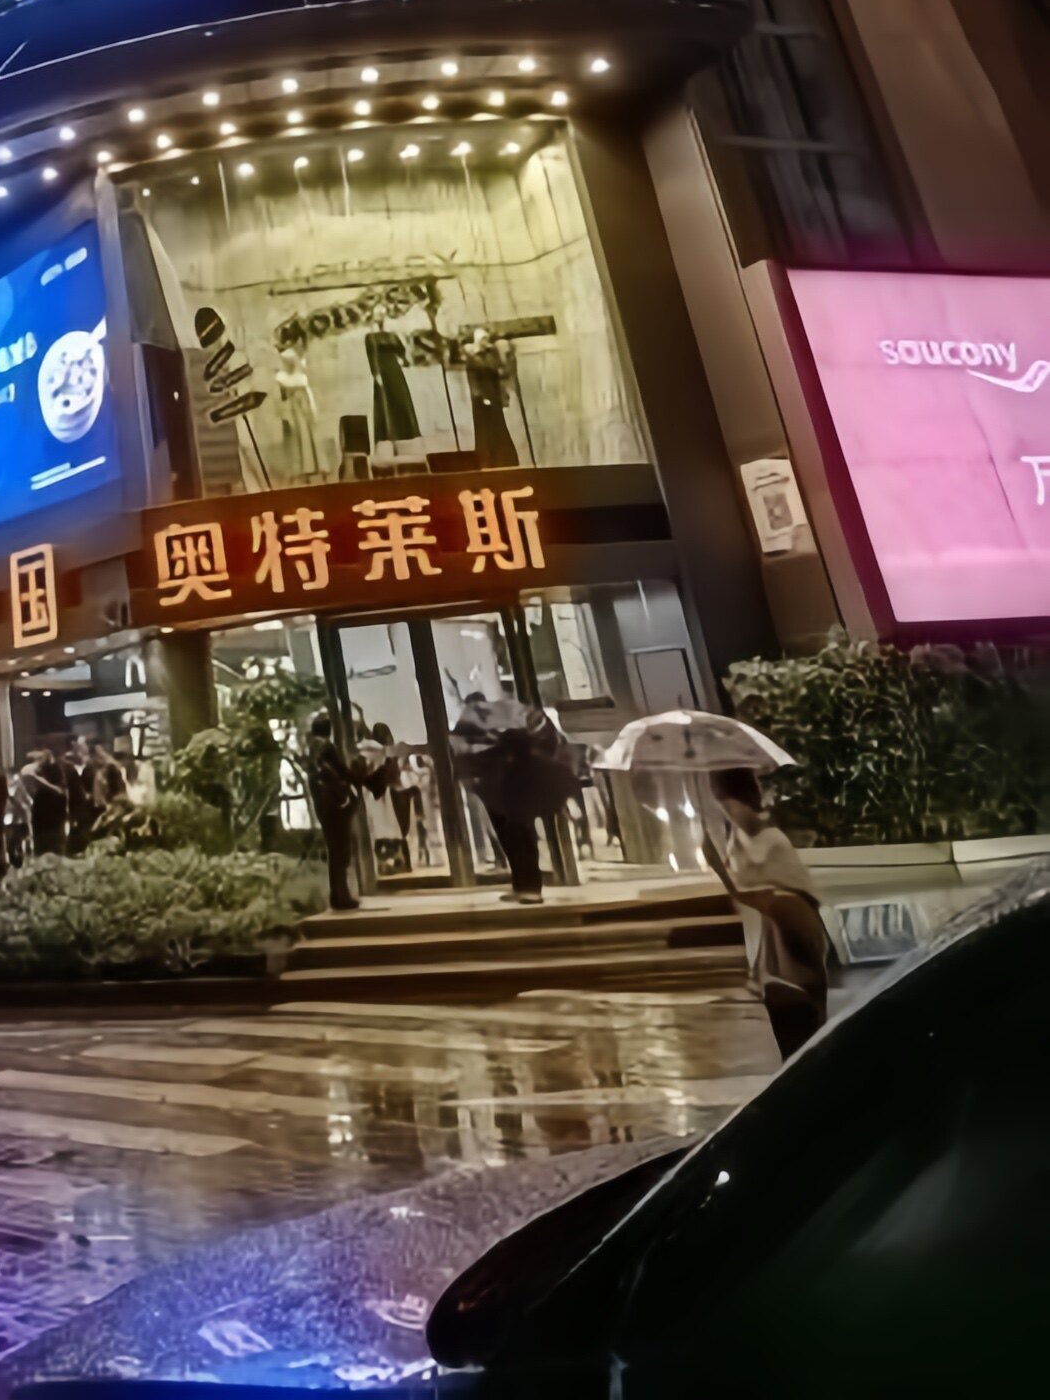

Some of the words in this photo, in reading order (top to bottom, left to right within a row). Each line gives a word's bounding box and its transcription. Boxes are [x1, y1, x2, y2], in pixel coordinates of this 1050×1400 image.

[879, 339, 1017, 372] saucony
[153, 486, 546, 606] 奥特莱斯
